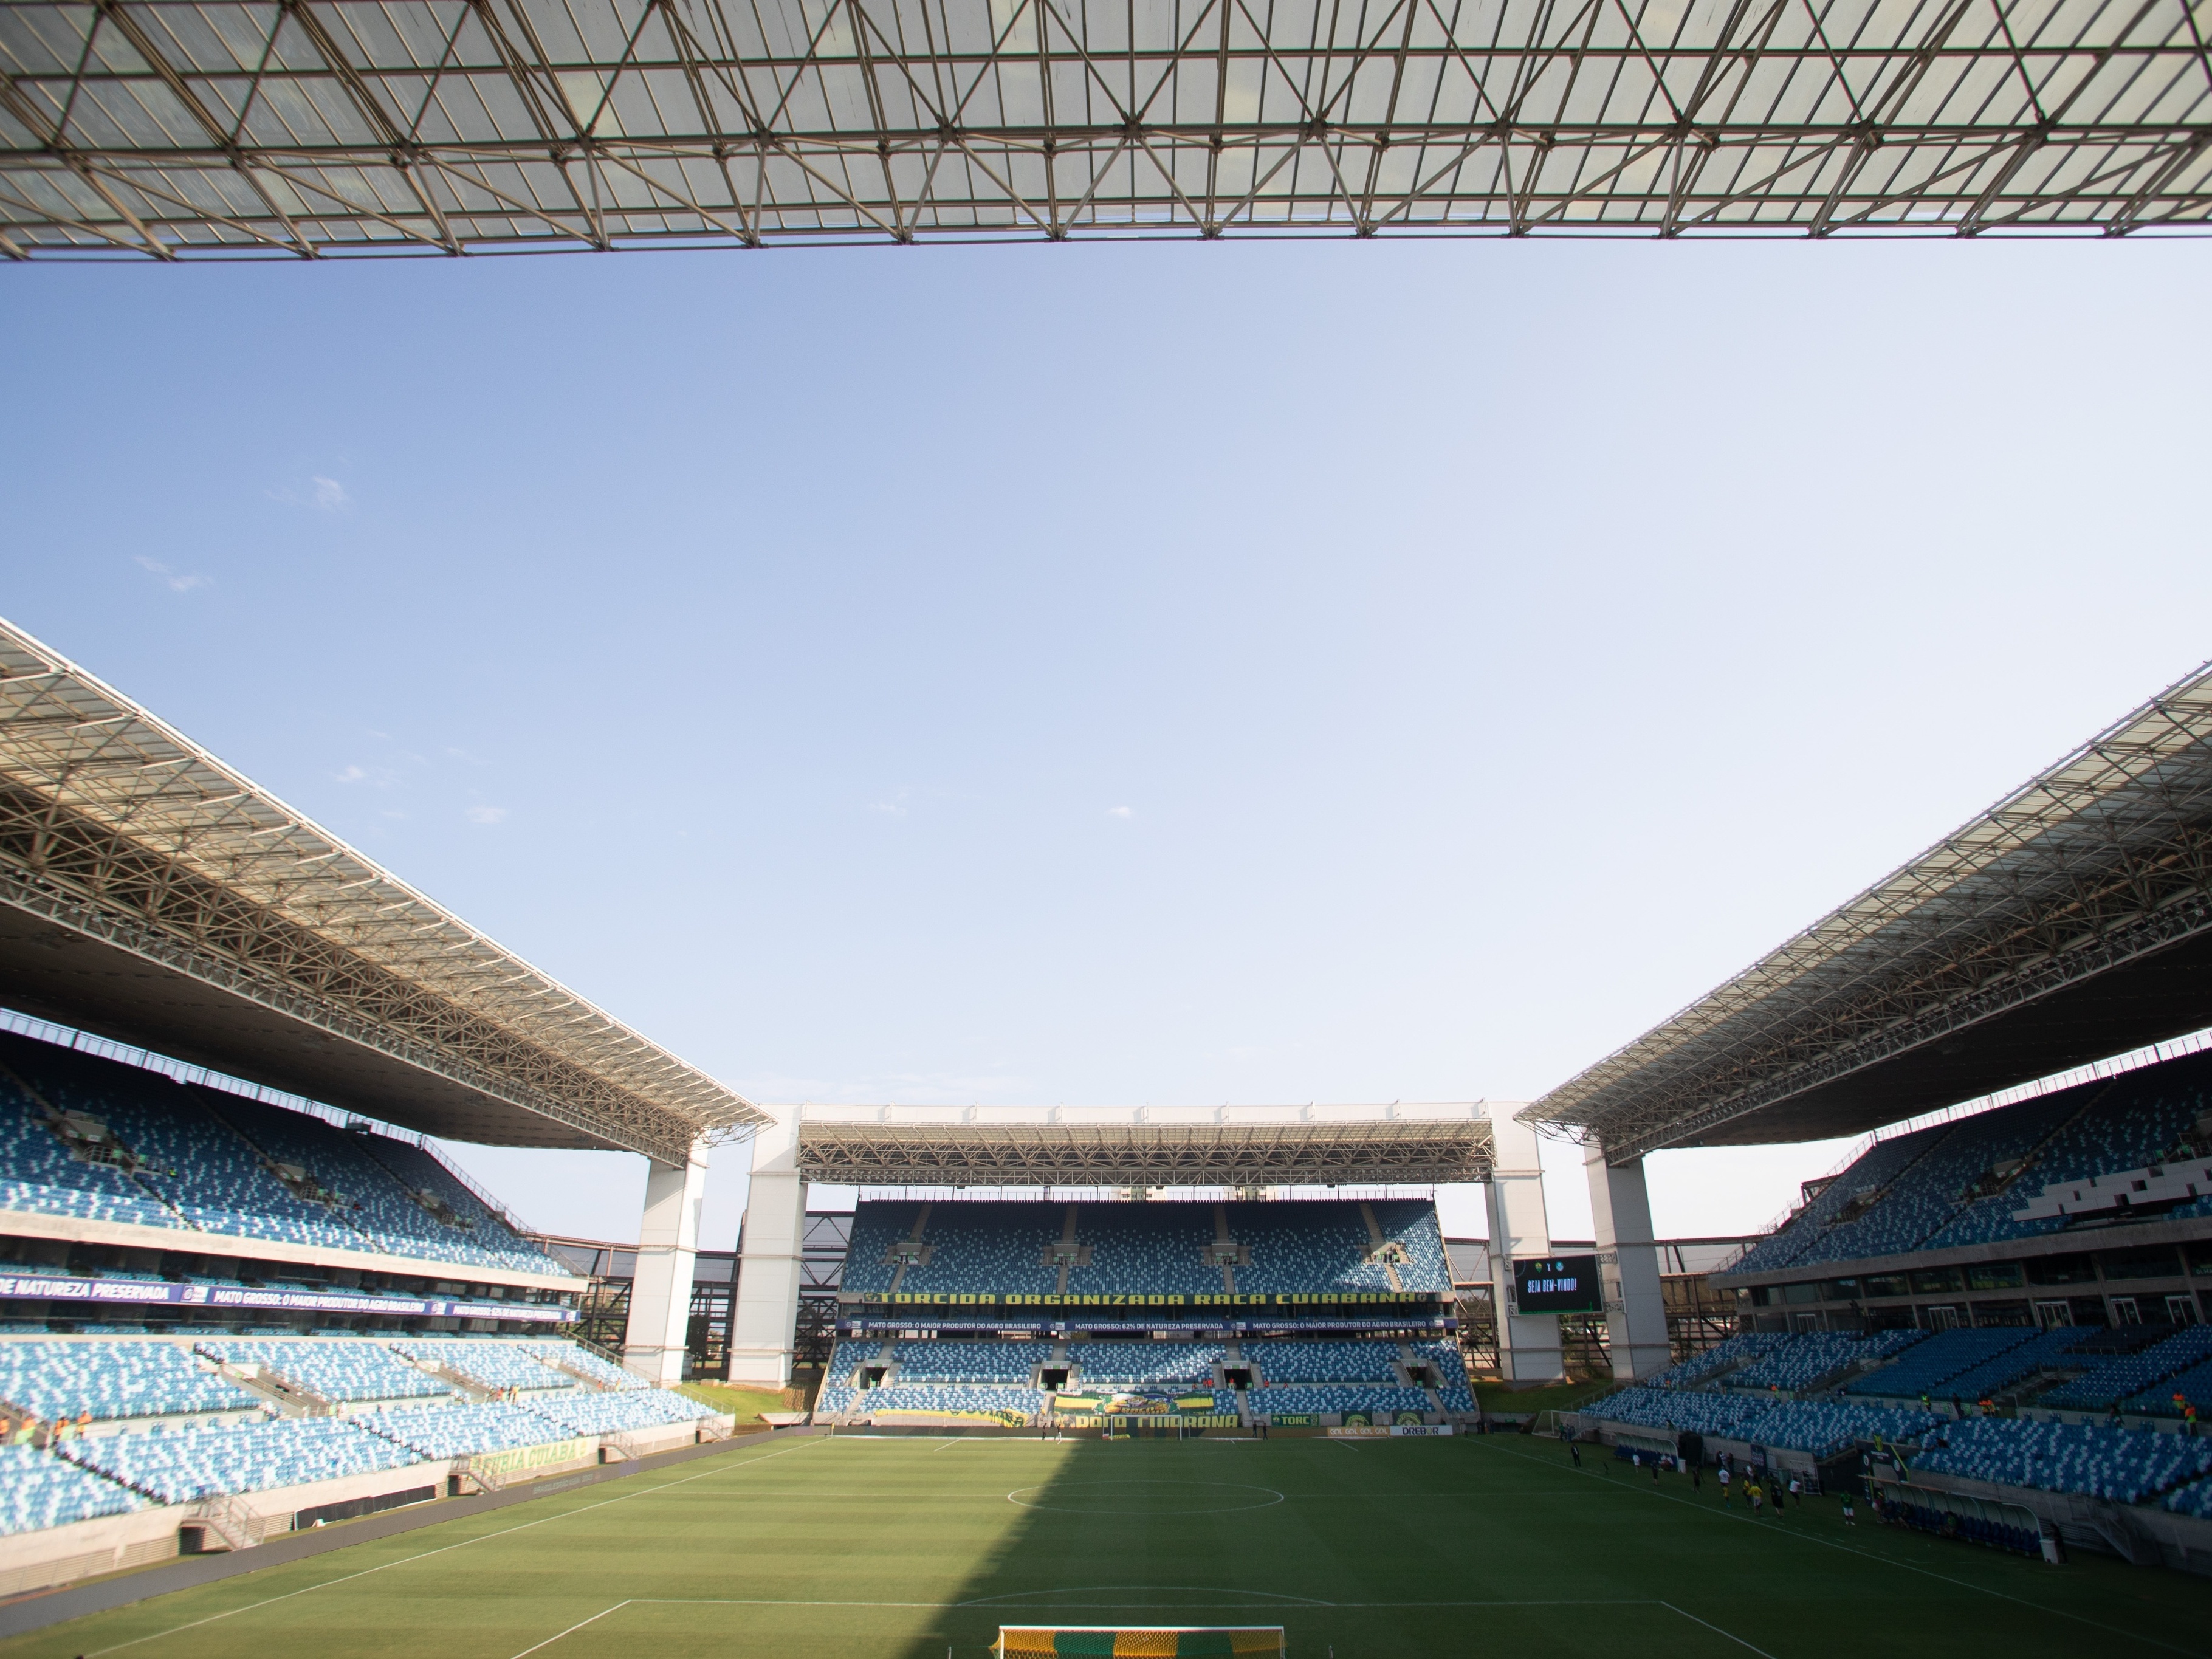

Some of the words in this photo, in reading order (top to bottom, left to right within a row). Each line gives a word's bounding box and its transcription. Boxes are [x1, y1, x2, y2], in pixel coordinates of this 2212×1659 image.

[15, 1279, 91, 1297] NATUREZA
[91, 1283, 170, 1300] PRESERVADA
[1528, 1280, 1540, 1293] SEJA
[1542, 1278, 1576, 1292] BEM-VINDO!
[213, 1290, 242, 1304] MATO
[243, 1291, 282, 1306] GROSSO:
[282, 1295, 290, 1306] O
[290, 1294, 317, 1307] MAIOR
[317, 1296, 358, 1309] PRODUTOR
[357, 1298, 369, 1310] DO
[368, 1299, 388, 1311] AGRO
[387, 1300, 425, 1313] BRASILEIRO
[878, 1293, 995, 1304] TORCIDA
[1005, 1294, 1184, 1305] ORGANIZADA
[1276, 1293, 1415, 1304] CUIABANA
[1282, 1416, 1309, 1424] TORC
[1402, 1427, 1438, 1435] DREBOR
